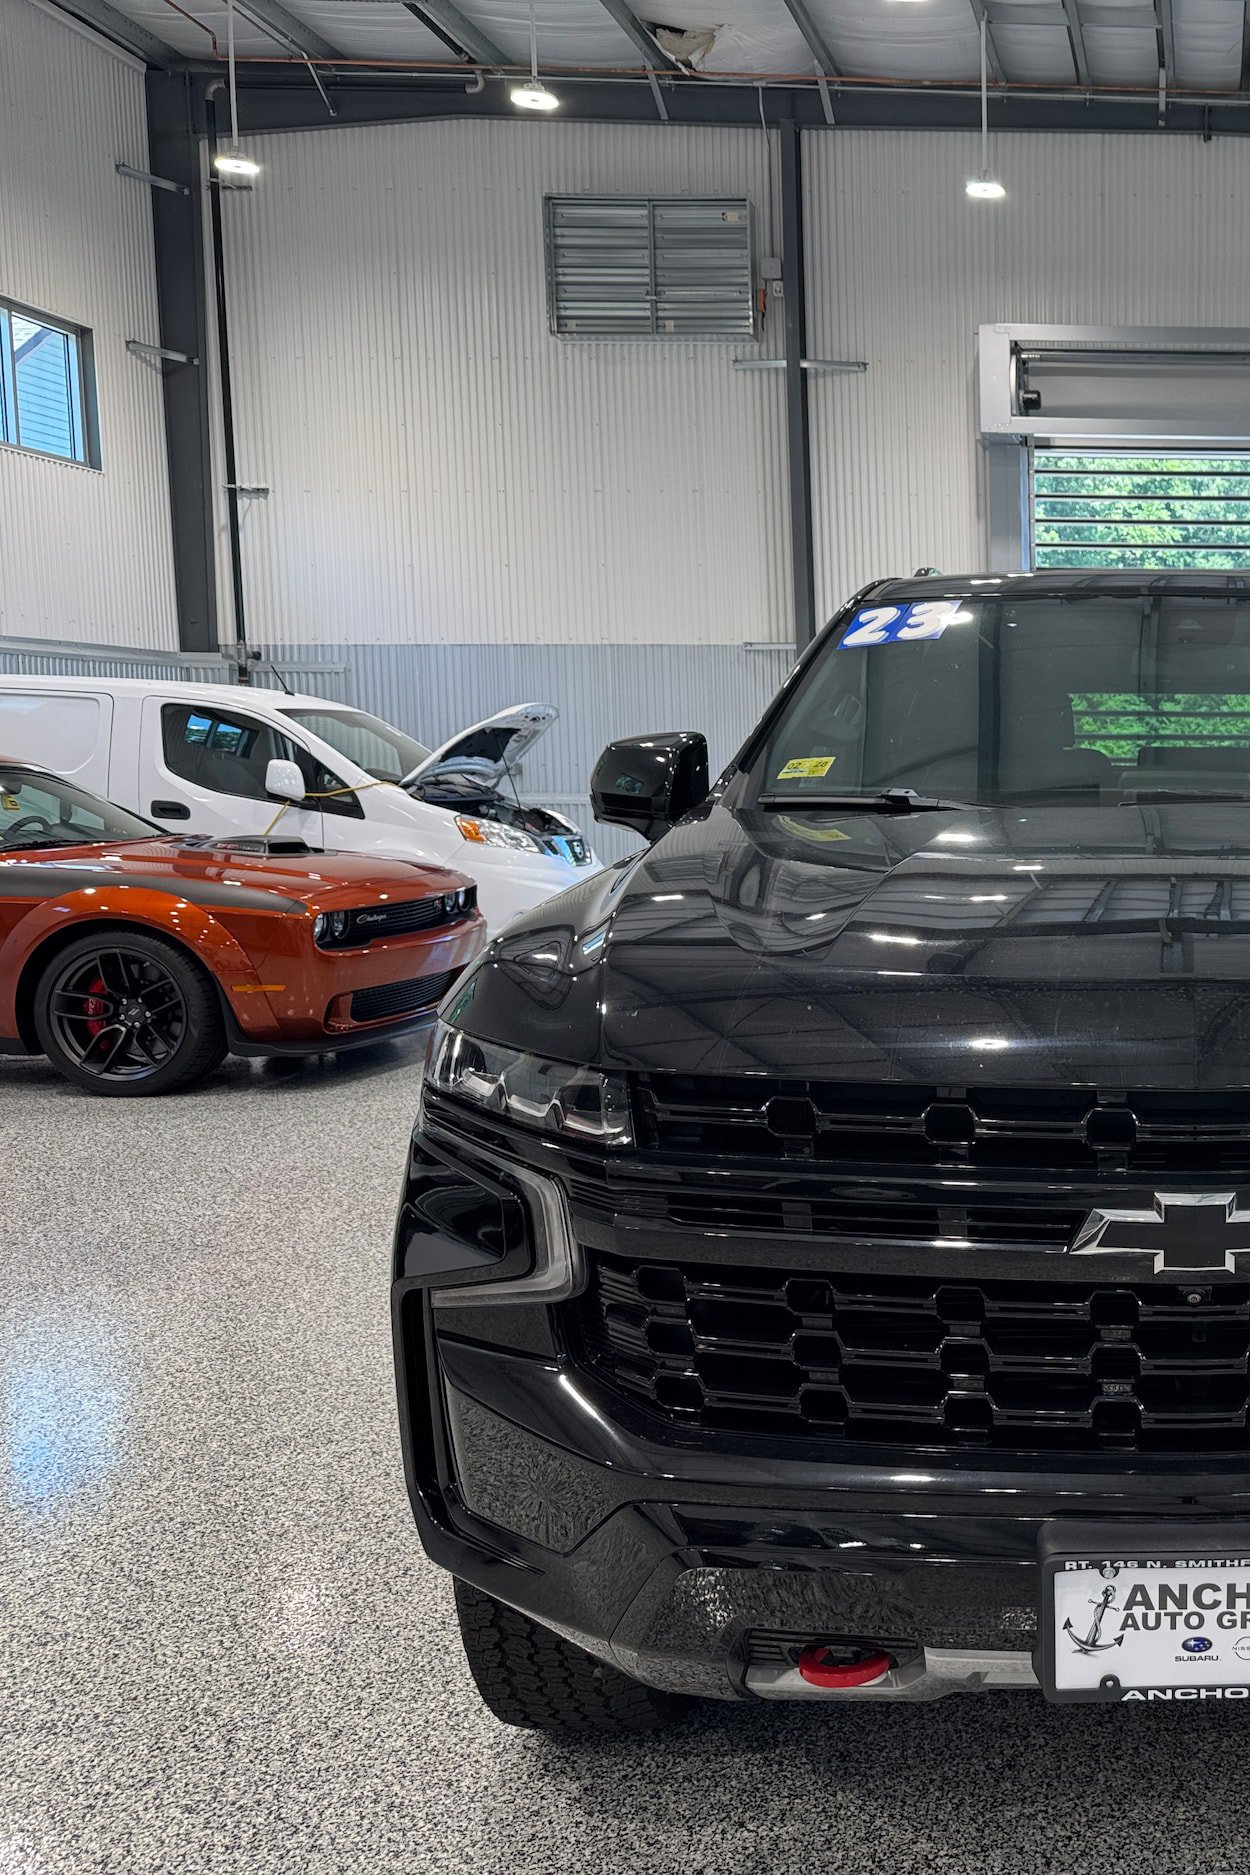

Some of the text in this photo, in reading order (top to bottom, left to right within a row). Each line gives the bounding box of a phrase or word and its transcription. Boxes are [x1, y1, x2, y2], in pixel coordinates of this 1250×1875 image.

[843, 602, 951, 646] 23
[1065, 1560, 1093, 1570] RT.
[1101, 1560, 1139, 1568] 146
[1146, 1560, 1167, 1568] N.
[1119, 1611, 1205, 1632] AUTO
